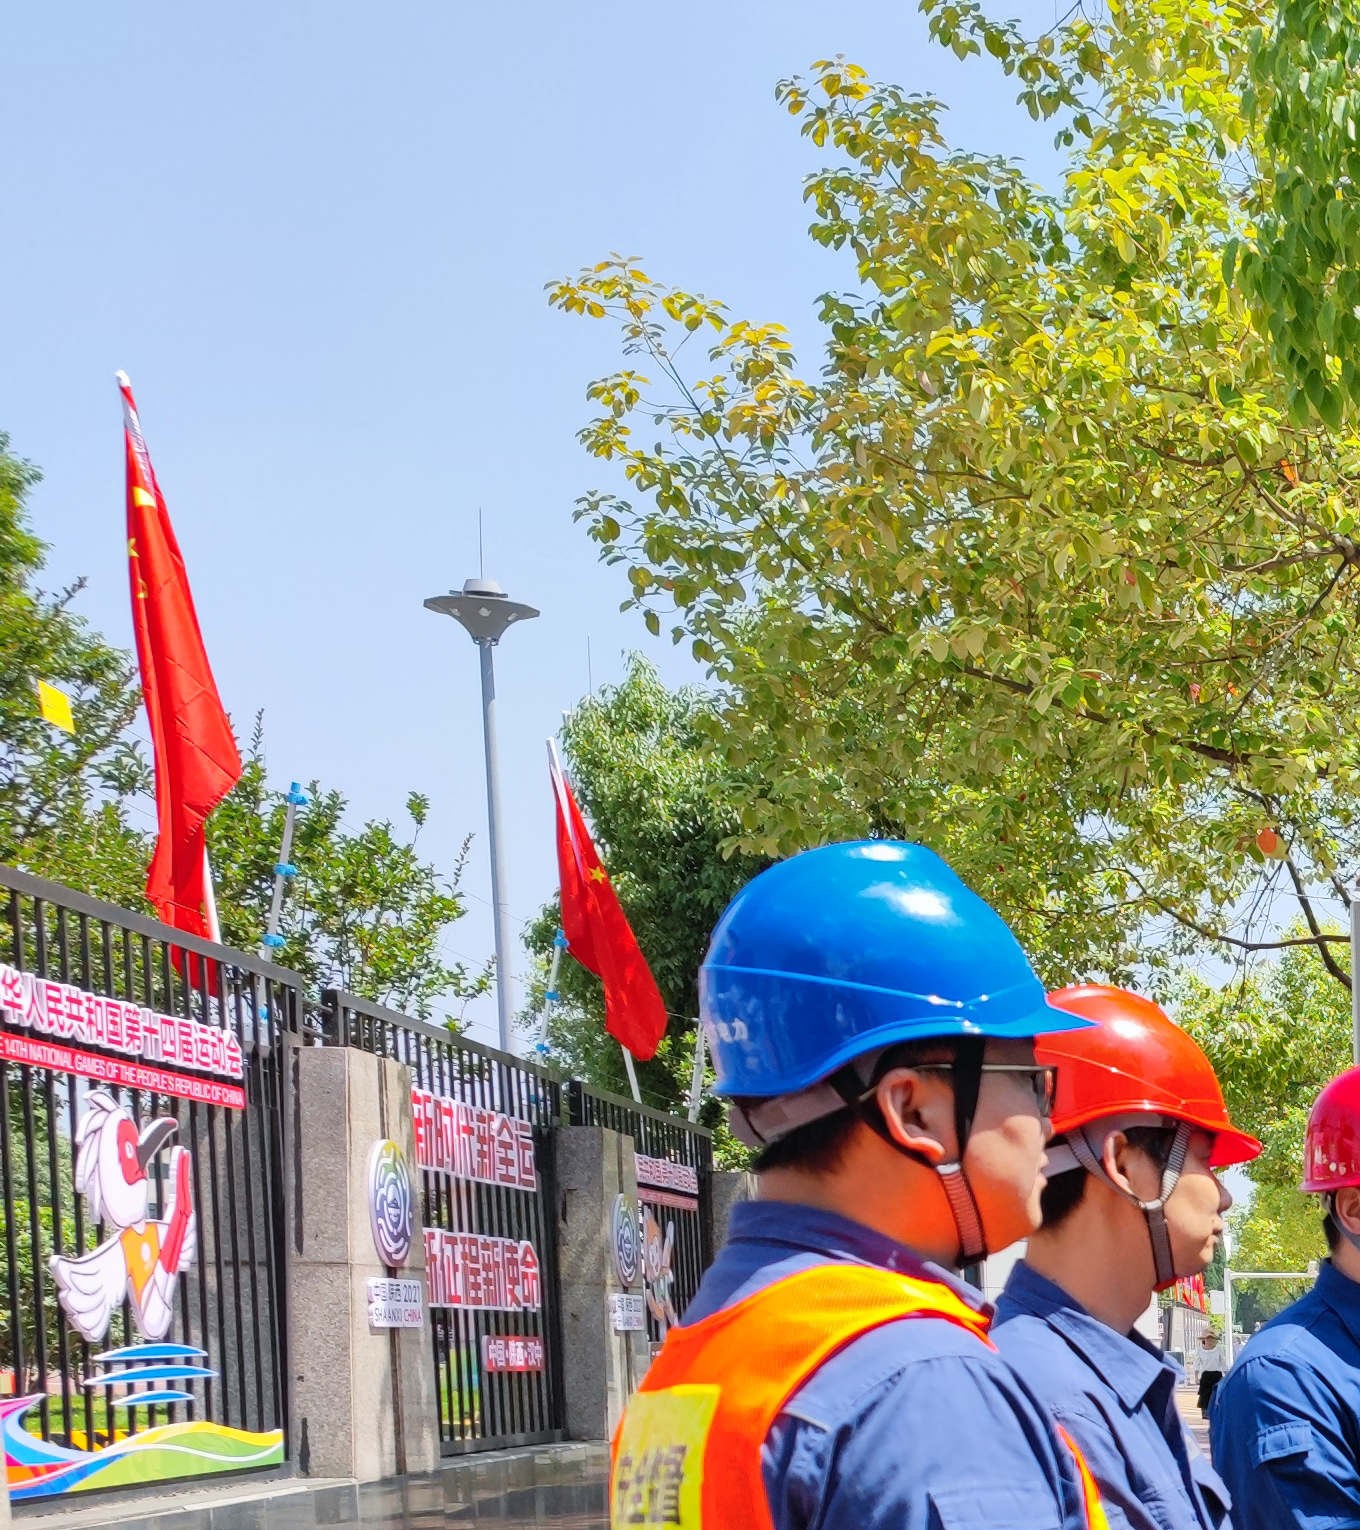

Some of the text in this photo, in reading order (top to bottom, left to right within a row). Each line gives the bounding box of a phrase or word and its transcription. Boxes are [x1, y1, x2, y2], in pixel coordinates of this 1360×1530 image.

[29, 1044, 73, 1069] NATIONAL
[75, 1055, 105, 1076] GAMES
[105, 1061, 119, 1079] OF
[119, 1063, 136, 1082] THE
[175, 1077, 211, 1099] REPUBLIC
[212, 1084, 222, 1102] OF
[223, 1086, 244, 1106] CHINA
[403, 1284, 421, 1303] 2021
[404, 1308, 421, 1322] CHINA
